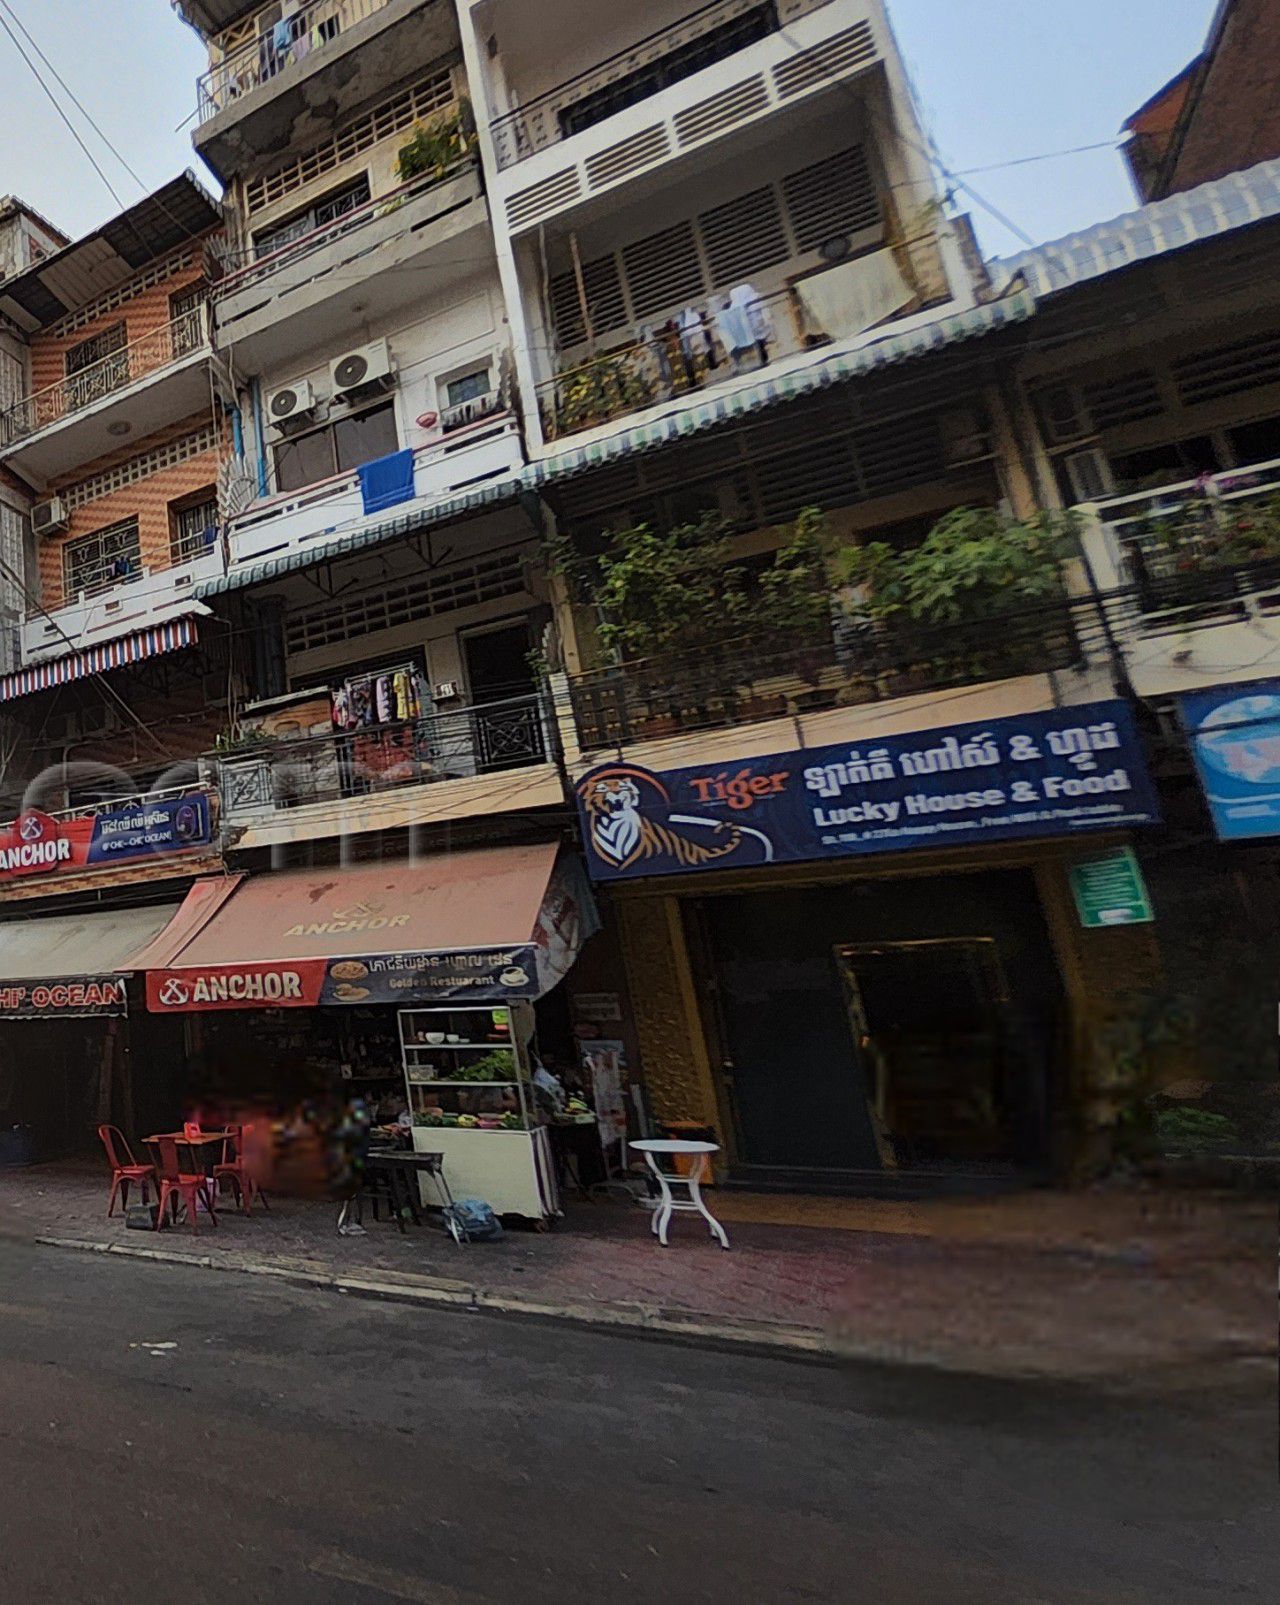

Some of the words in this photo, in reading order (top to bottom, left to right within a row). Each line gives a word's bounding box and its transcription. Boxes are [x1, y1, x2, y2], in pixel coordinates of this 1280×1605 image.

[1009, 735, 1043, 760] &
[689, 768, 790, 810] Tiger
[813, 801, 900, 826] Lucky
[904, 789, 1006, 815] House
[1011, 781, 1040, 802] &
[1042, 769, 1131, 798] Food
[283, 914, 411, 937] ANCHOR
[31, 983, 120, 1008] OCEAN
[193, 972, 302, 1002] ANCHOR
